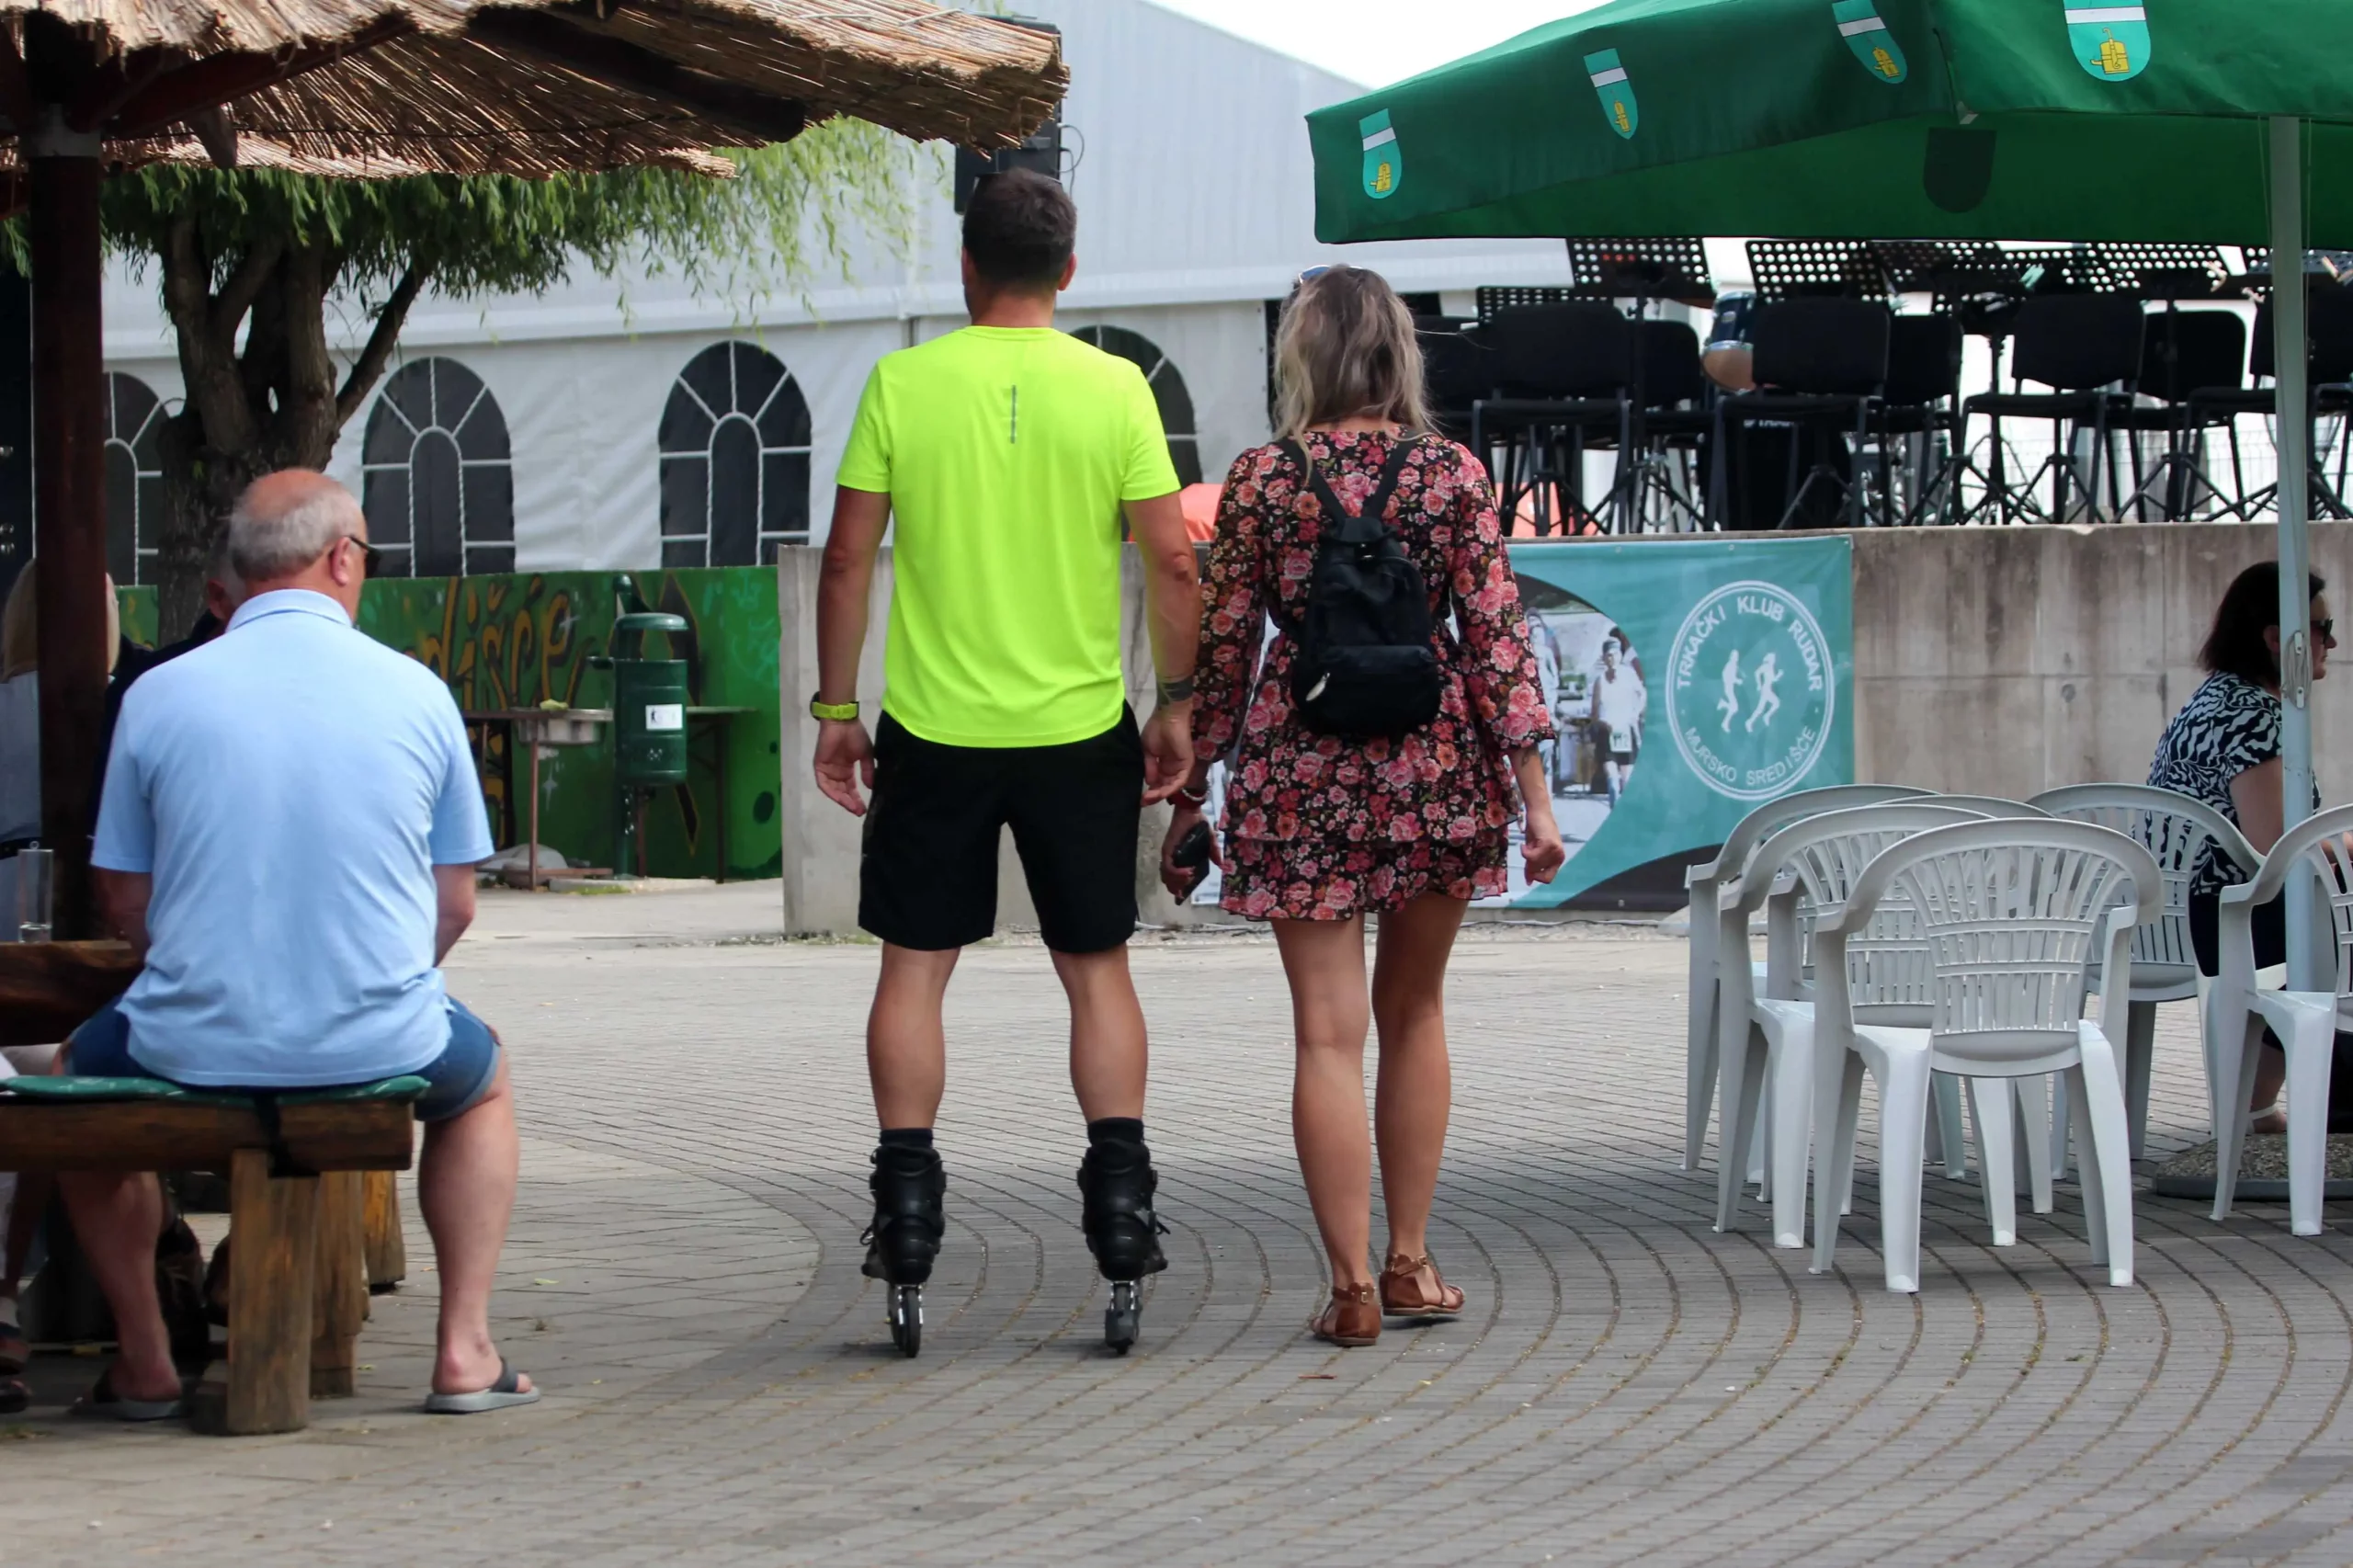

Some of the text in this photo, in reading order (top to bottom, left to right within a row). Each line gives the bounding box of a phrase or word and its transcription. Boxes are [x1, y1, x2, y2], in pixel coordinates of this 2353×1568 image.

[1677, 596, 1824, 691] TRKAČKI KLUB RUDAR
[1685, 727, 1737, 781] MURSKO
